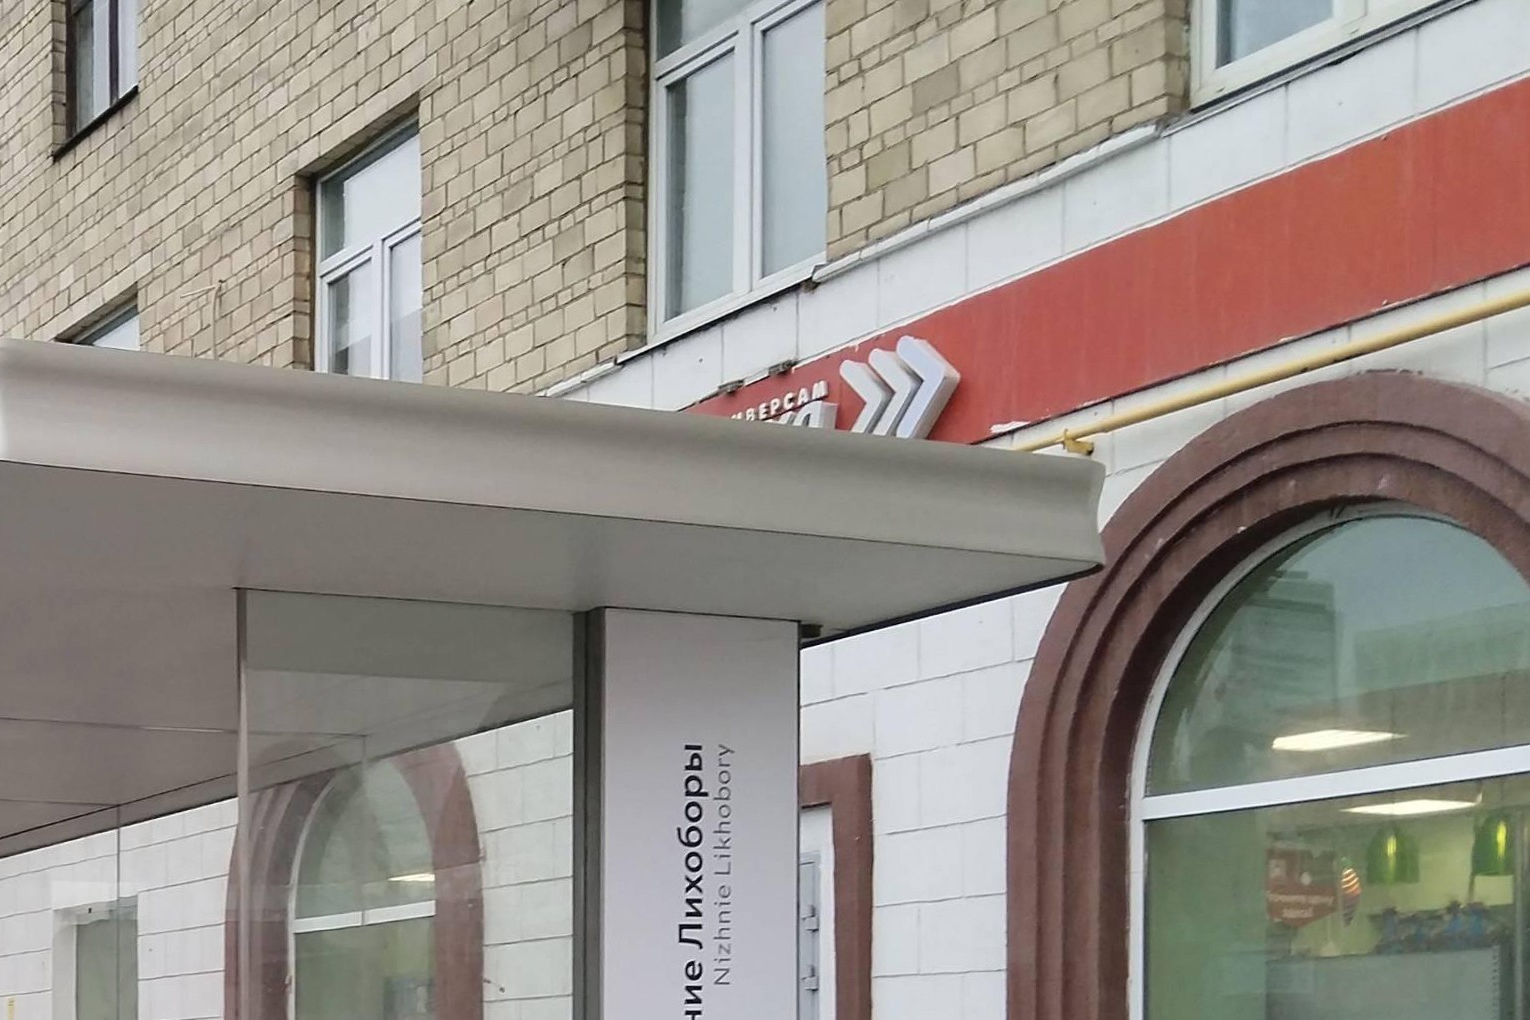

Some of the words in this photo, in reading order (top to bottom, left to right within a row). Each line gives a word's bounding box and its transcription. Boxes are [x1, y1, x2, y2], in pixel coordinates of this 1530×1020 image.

[677, 743, 709, 951] Лихоборы
[713, 743, 735, 876] Likhobory
[713, 884, 731, 986] Nizhnie
